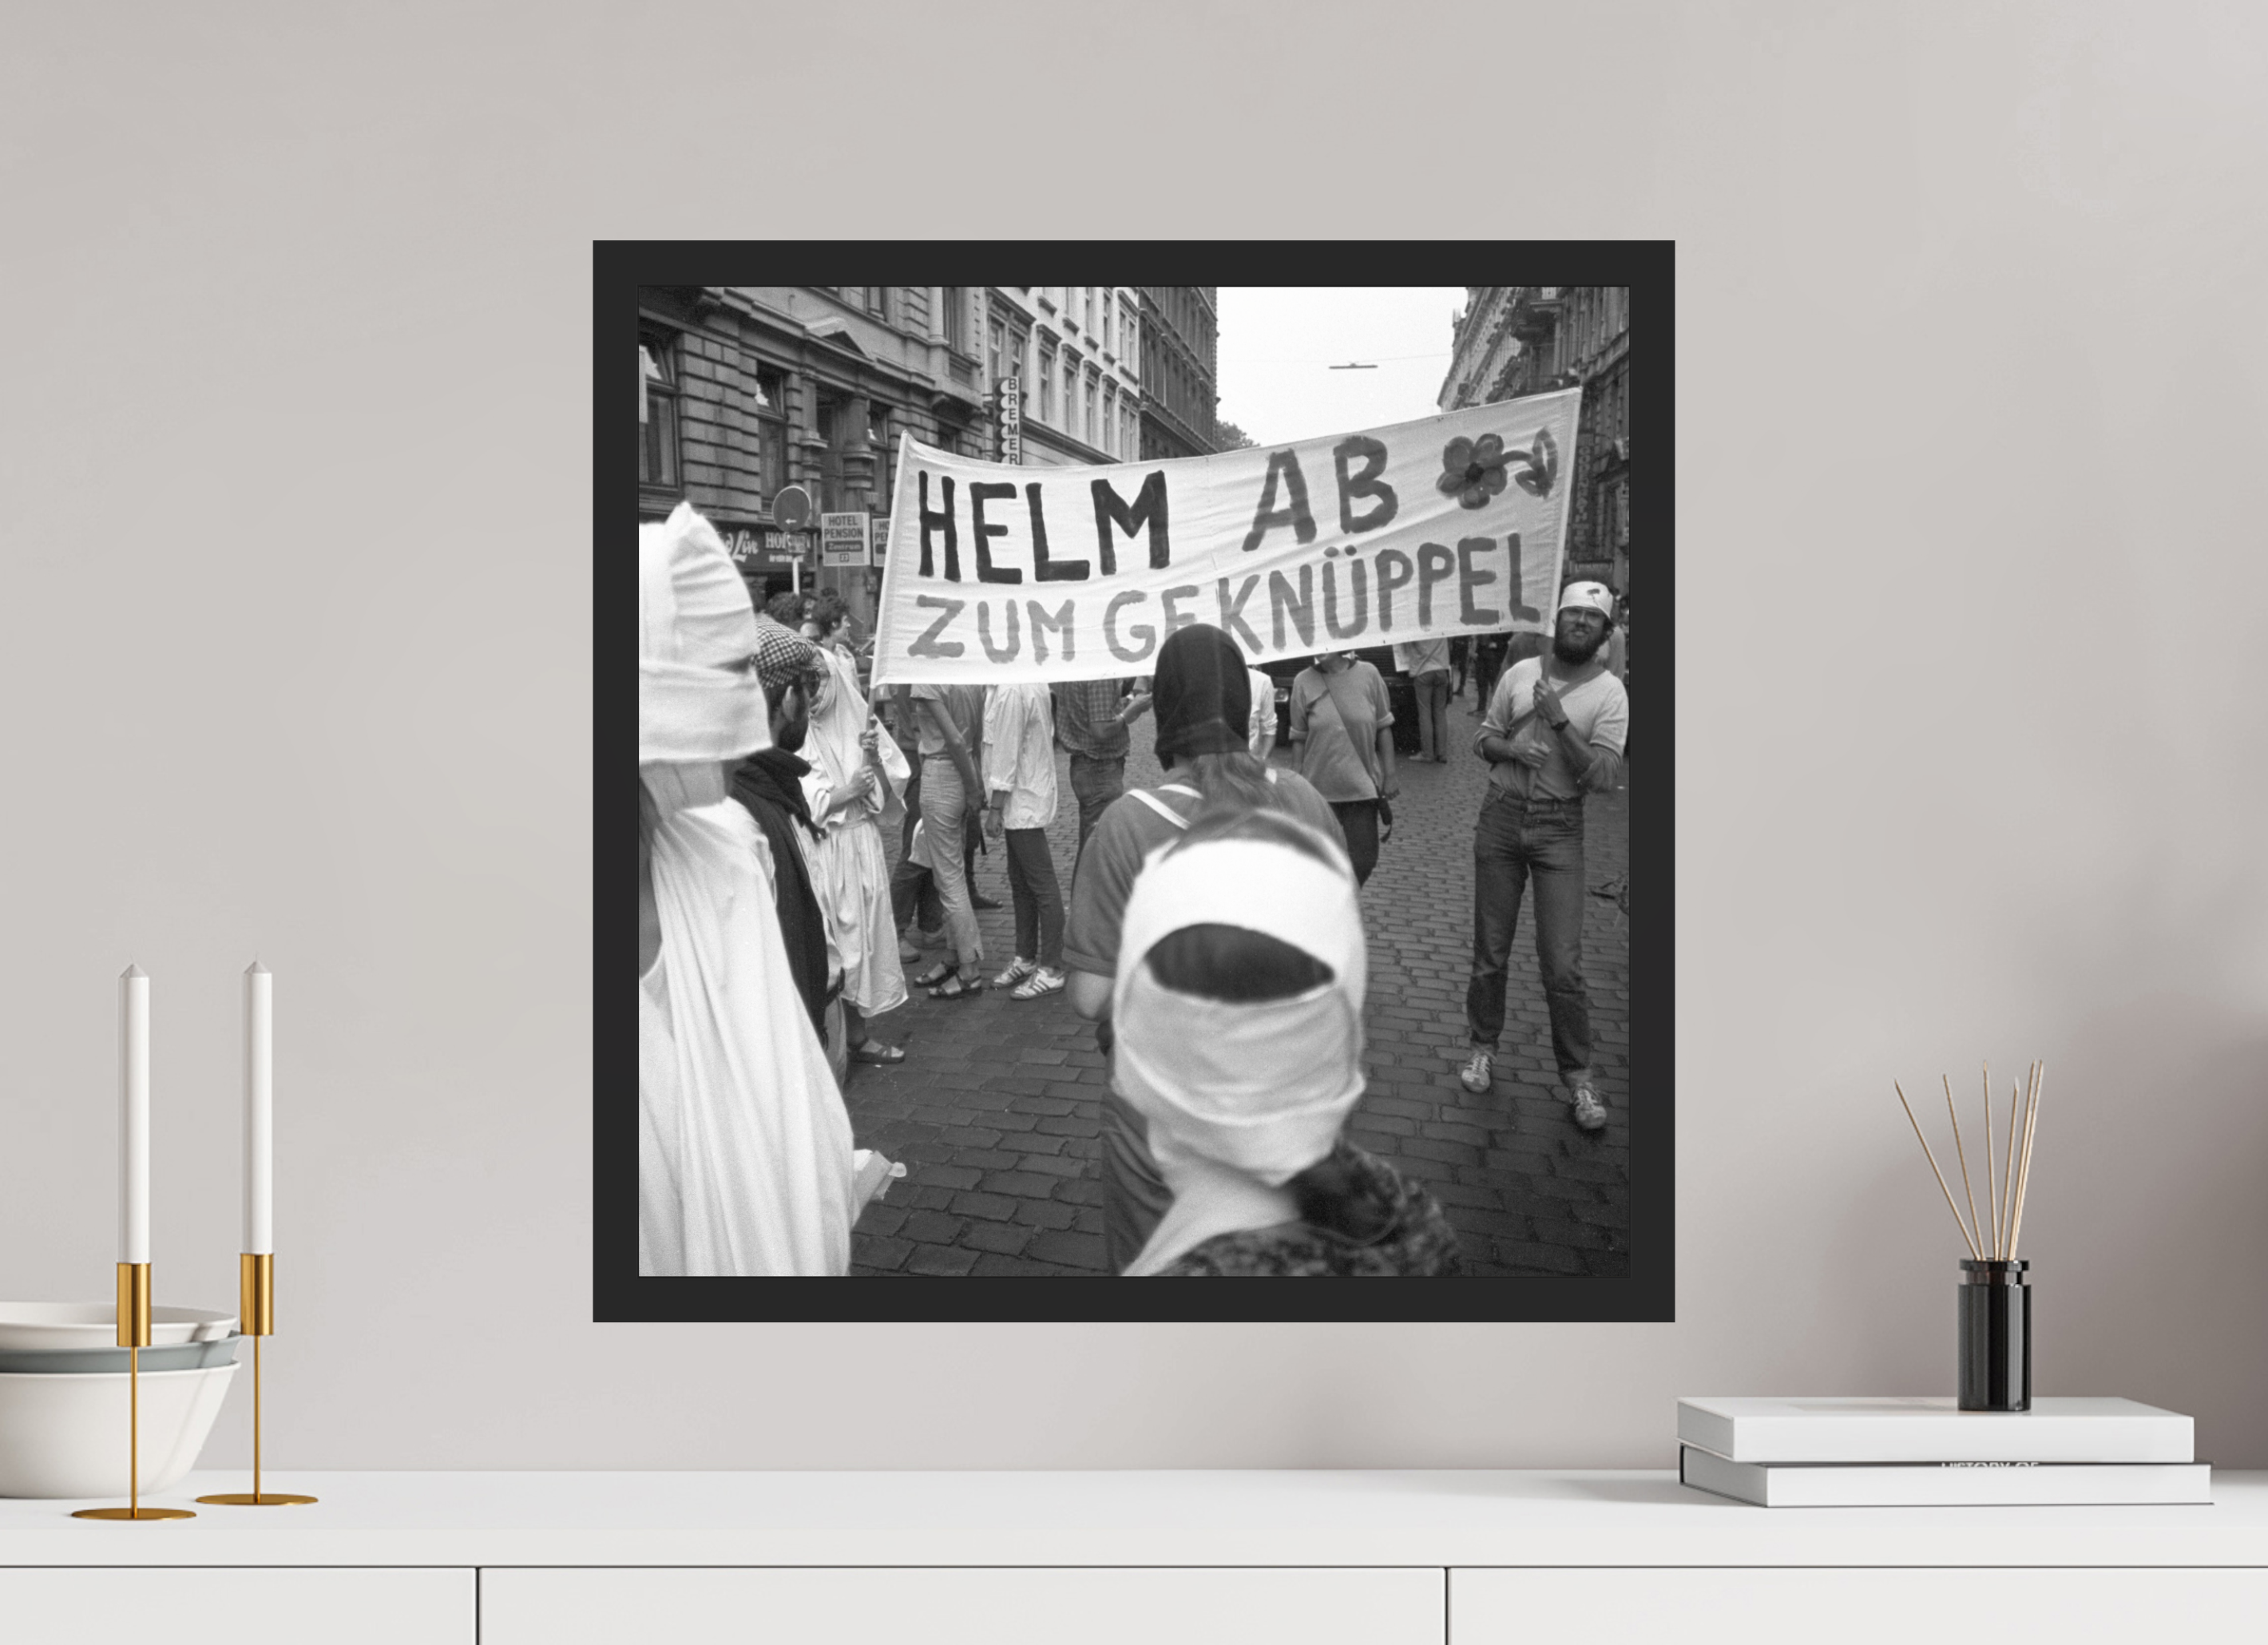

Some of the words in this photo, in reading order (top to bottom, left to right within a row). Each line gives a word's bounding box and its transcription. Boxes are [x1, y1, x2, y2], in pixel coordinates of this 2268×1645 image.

[1008, 378, 1018, 465] BREMER
[824, 528, 863, 538] PENSION
[828, 516, 858, 526] HOTEL
[918, 470, 1170, 584] HELM
[1243, 435, 1399, 553] AB
[908, 589, 1075, 665] ZUM
[1103, 533, 1541, 663] GEKNÜPPEL
